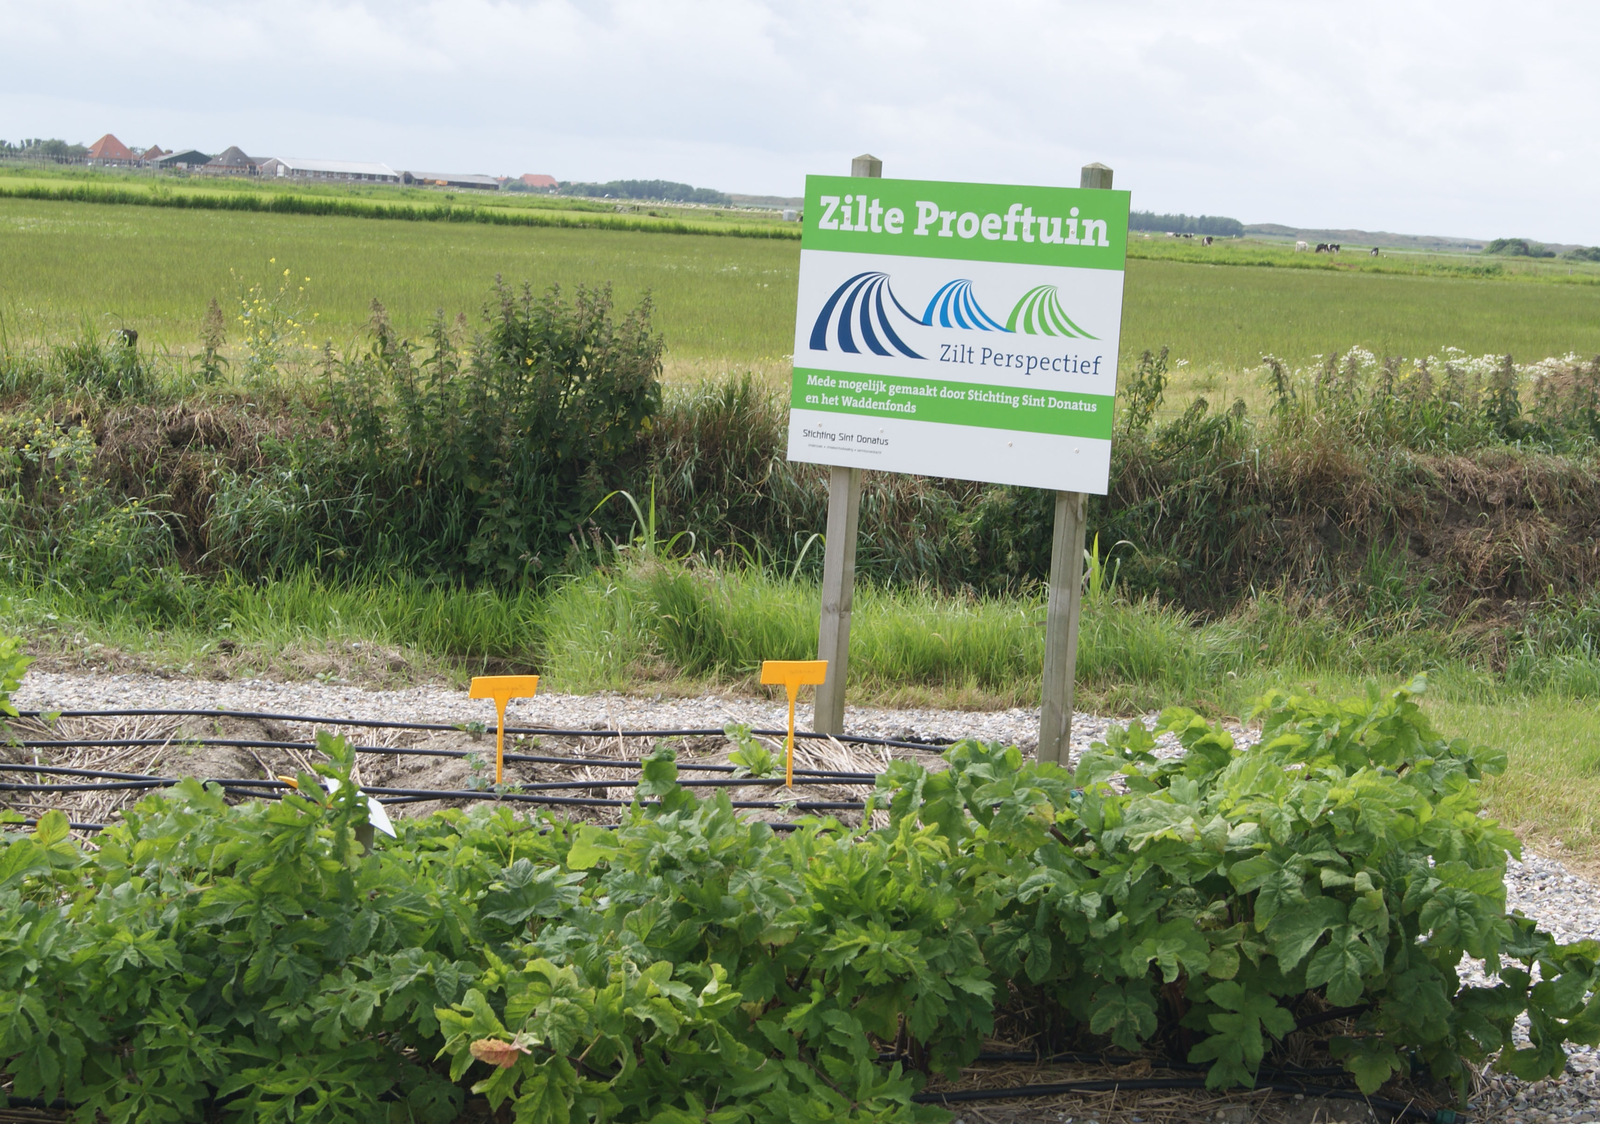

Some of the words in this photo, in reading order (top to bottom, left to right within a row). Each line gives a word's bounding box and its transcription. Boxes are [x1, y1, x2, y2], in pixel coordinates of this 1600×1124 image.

[819, 194, 904, 233] Zilte
[913, 200, 1110, 247] Proeftuin
[939, 344, 974, 364] Zilt
[980, 348, 1102, 375] Perspectief
[805, 394, 819, 405] en
[821, 394, 838, 406] het
[842, 396, 917, 413] Waddenfonds
[806, 375, 837, 388] Mede
[839, 380, 886, 394] mogelijk
[889, 384, 937, 398] gemaakt
[940, 387, 965, 400] door
[968, 389, 1020, 407] Stichting
[1022, 394, 1045, 407] Sint
[1047, 397, 1097, 412] Donatus
[802, 428, 836, 442] Stichting
[838, 432, 854, 442] Sint
[856, 434, 889, 446] Donatus
